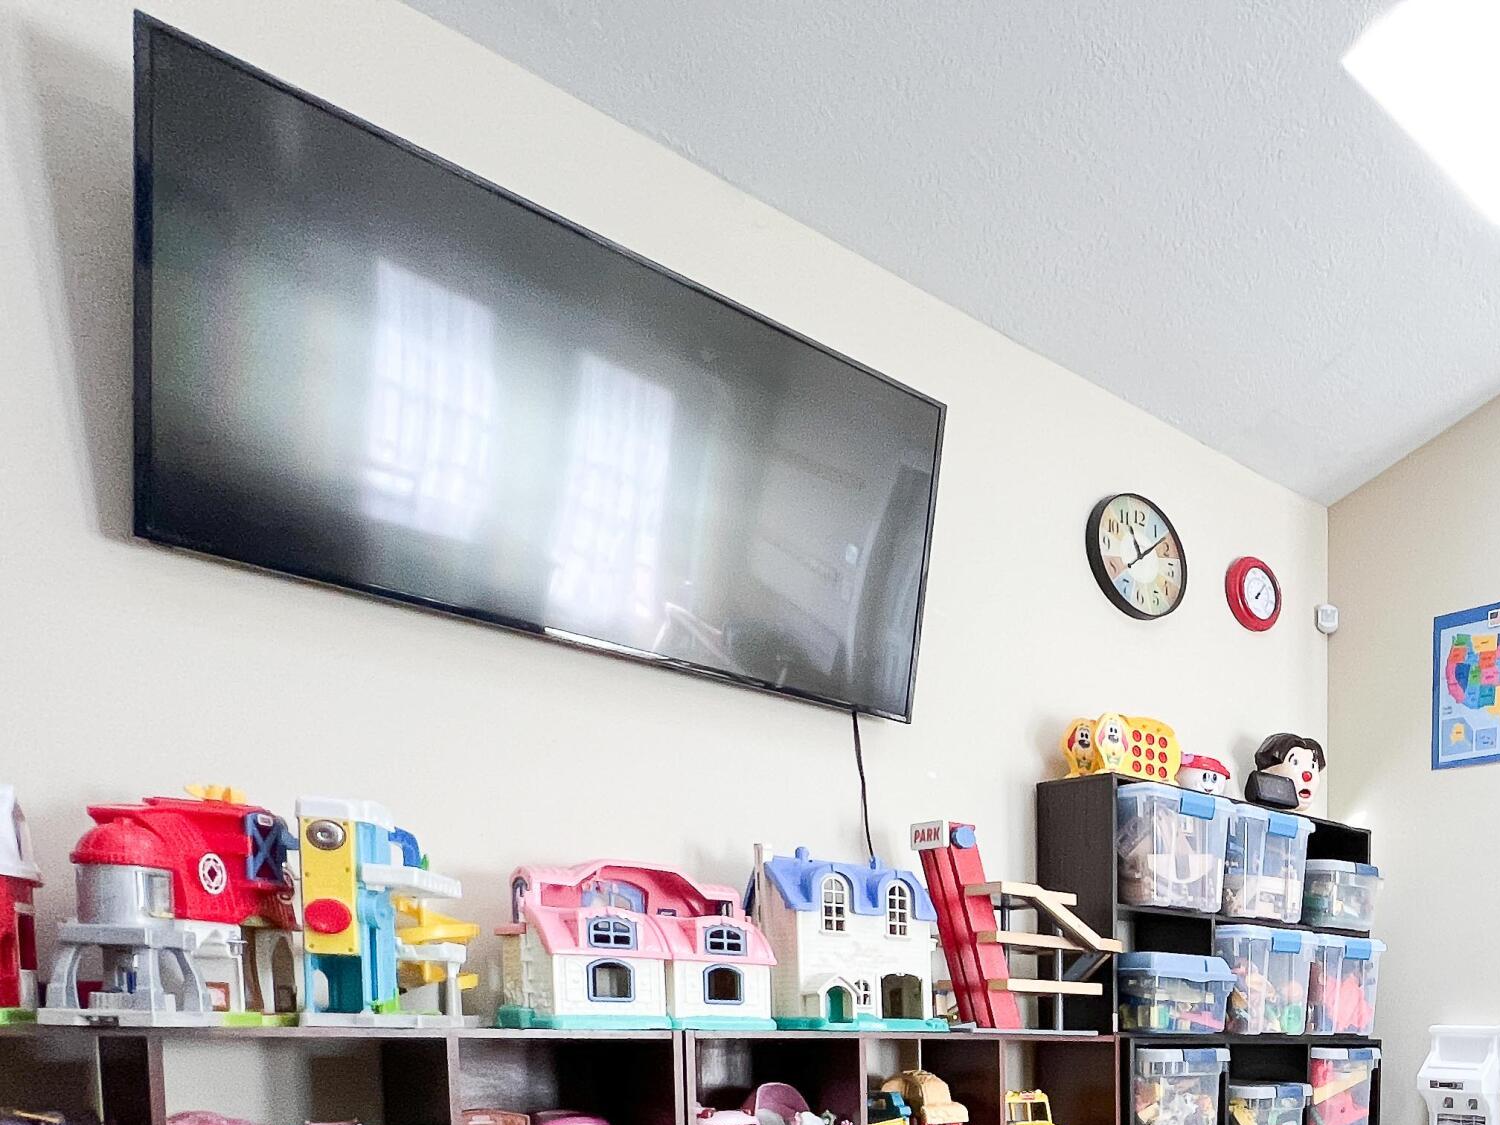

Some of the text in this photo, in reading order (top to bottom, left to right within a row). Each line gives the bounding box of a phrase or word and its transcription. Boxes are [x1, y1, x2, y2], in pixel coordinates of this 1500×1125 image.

[1120, 509, 1129, 525] 11
[1134, 509, 1146, 527] 12
[1108, 519, 1119, 535] 10
[1102, 535, 1111, 550] 9
[1162, 541, 1170, 557] 2
[1152, 590, 1160, 606] 5
[914, 826, 940, 844] PARK
